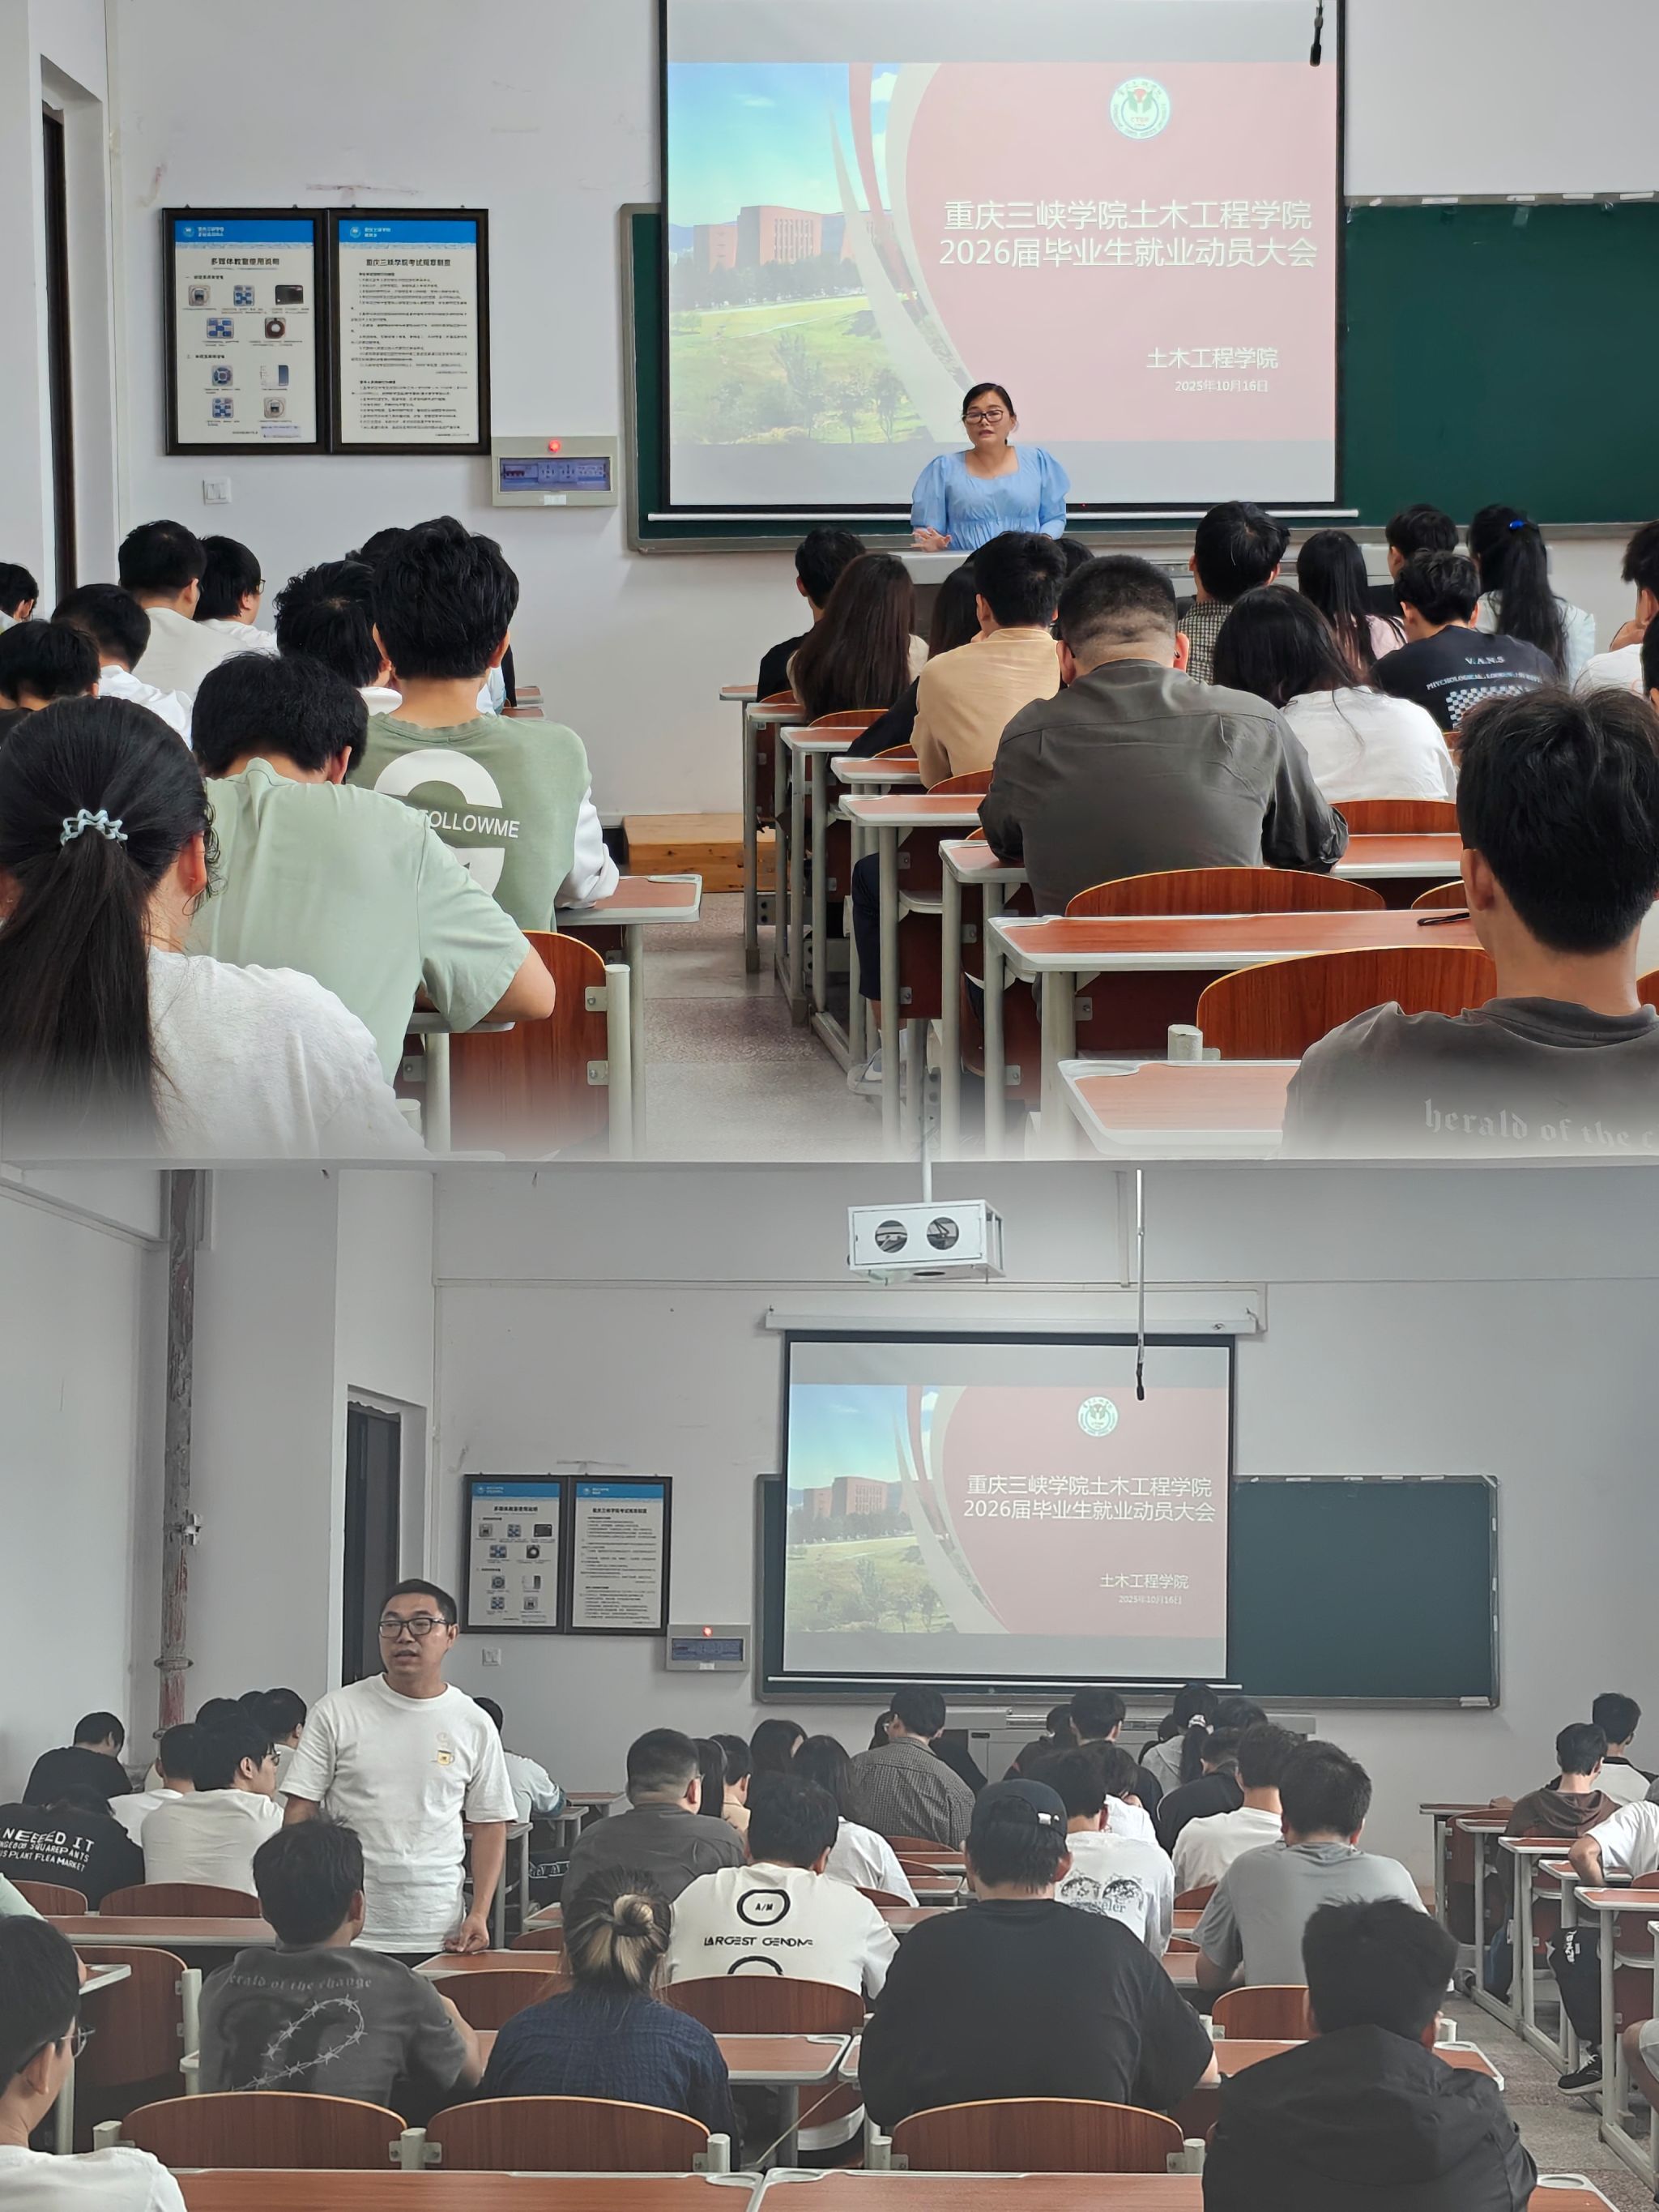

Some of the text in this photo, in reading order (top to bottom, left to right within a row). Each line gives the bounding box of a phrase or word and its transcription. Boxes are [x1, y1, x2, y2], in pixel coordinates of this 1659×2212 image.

[943, 199, 1312, 231] 重庆三峡学院土木工程学院
[939, 237, 1318, 268] 2026届毕业生就业动员大会
[1146, 347, 1279, 369] 土木工程学院
[1175, 379, 1269, 392] 2025年10月16日
[1424, 1098, 1529, 1140] herald
[1540, 1117, 1572, 1142] of
[1580, 1121, 1631, 1148] the
[966, 1474, 1213, 1497] 重庆三峡学院土木工程学院
[963, 1499, 1216, 1522] 2026届毕业生就业动员大会
[1099, 1572, 1189, 1590] 土木工程学院
[29, 1843, 90, 1863] SQUAREPANTS
[72, 1836, 95, 1852] IT
[8, 1851, 33, 1861] PLANT
[34, 1852, 56, 1863] FLEA
[56, 1857, 86, 1873] MARKET
[704, 1936, 757, 1946] LARGEST
